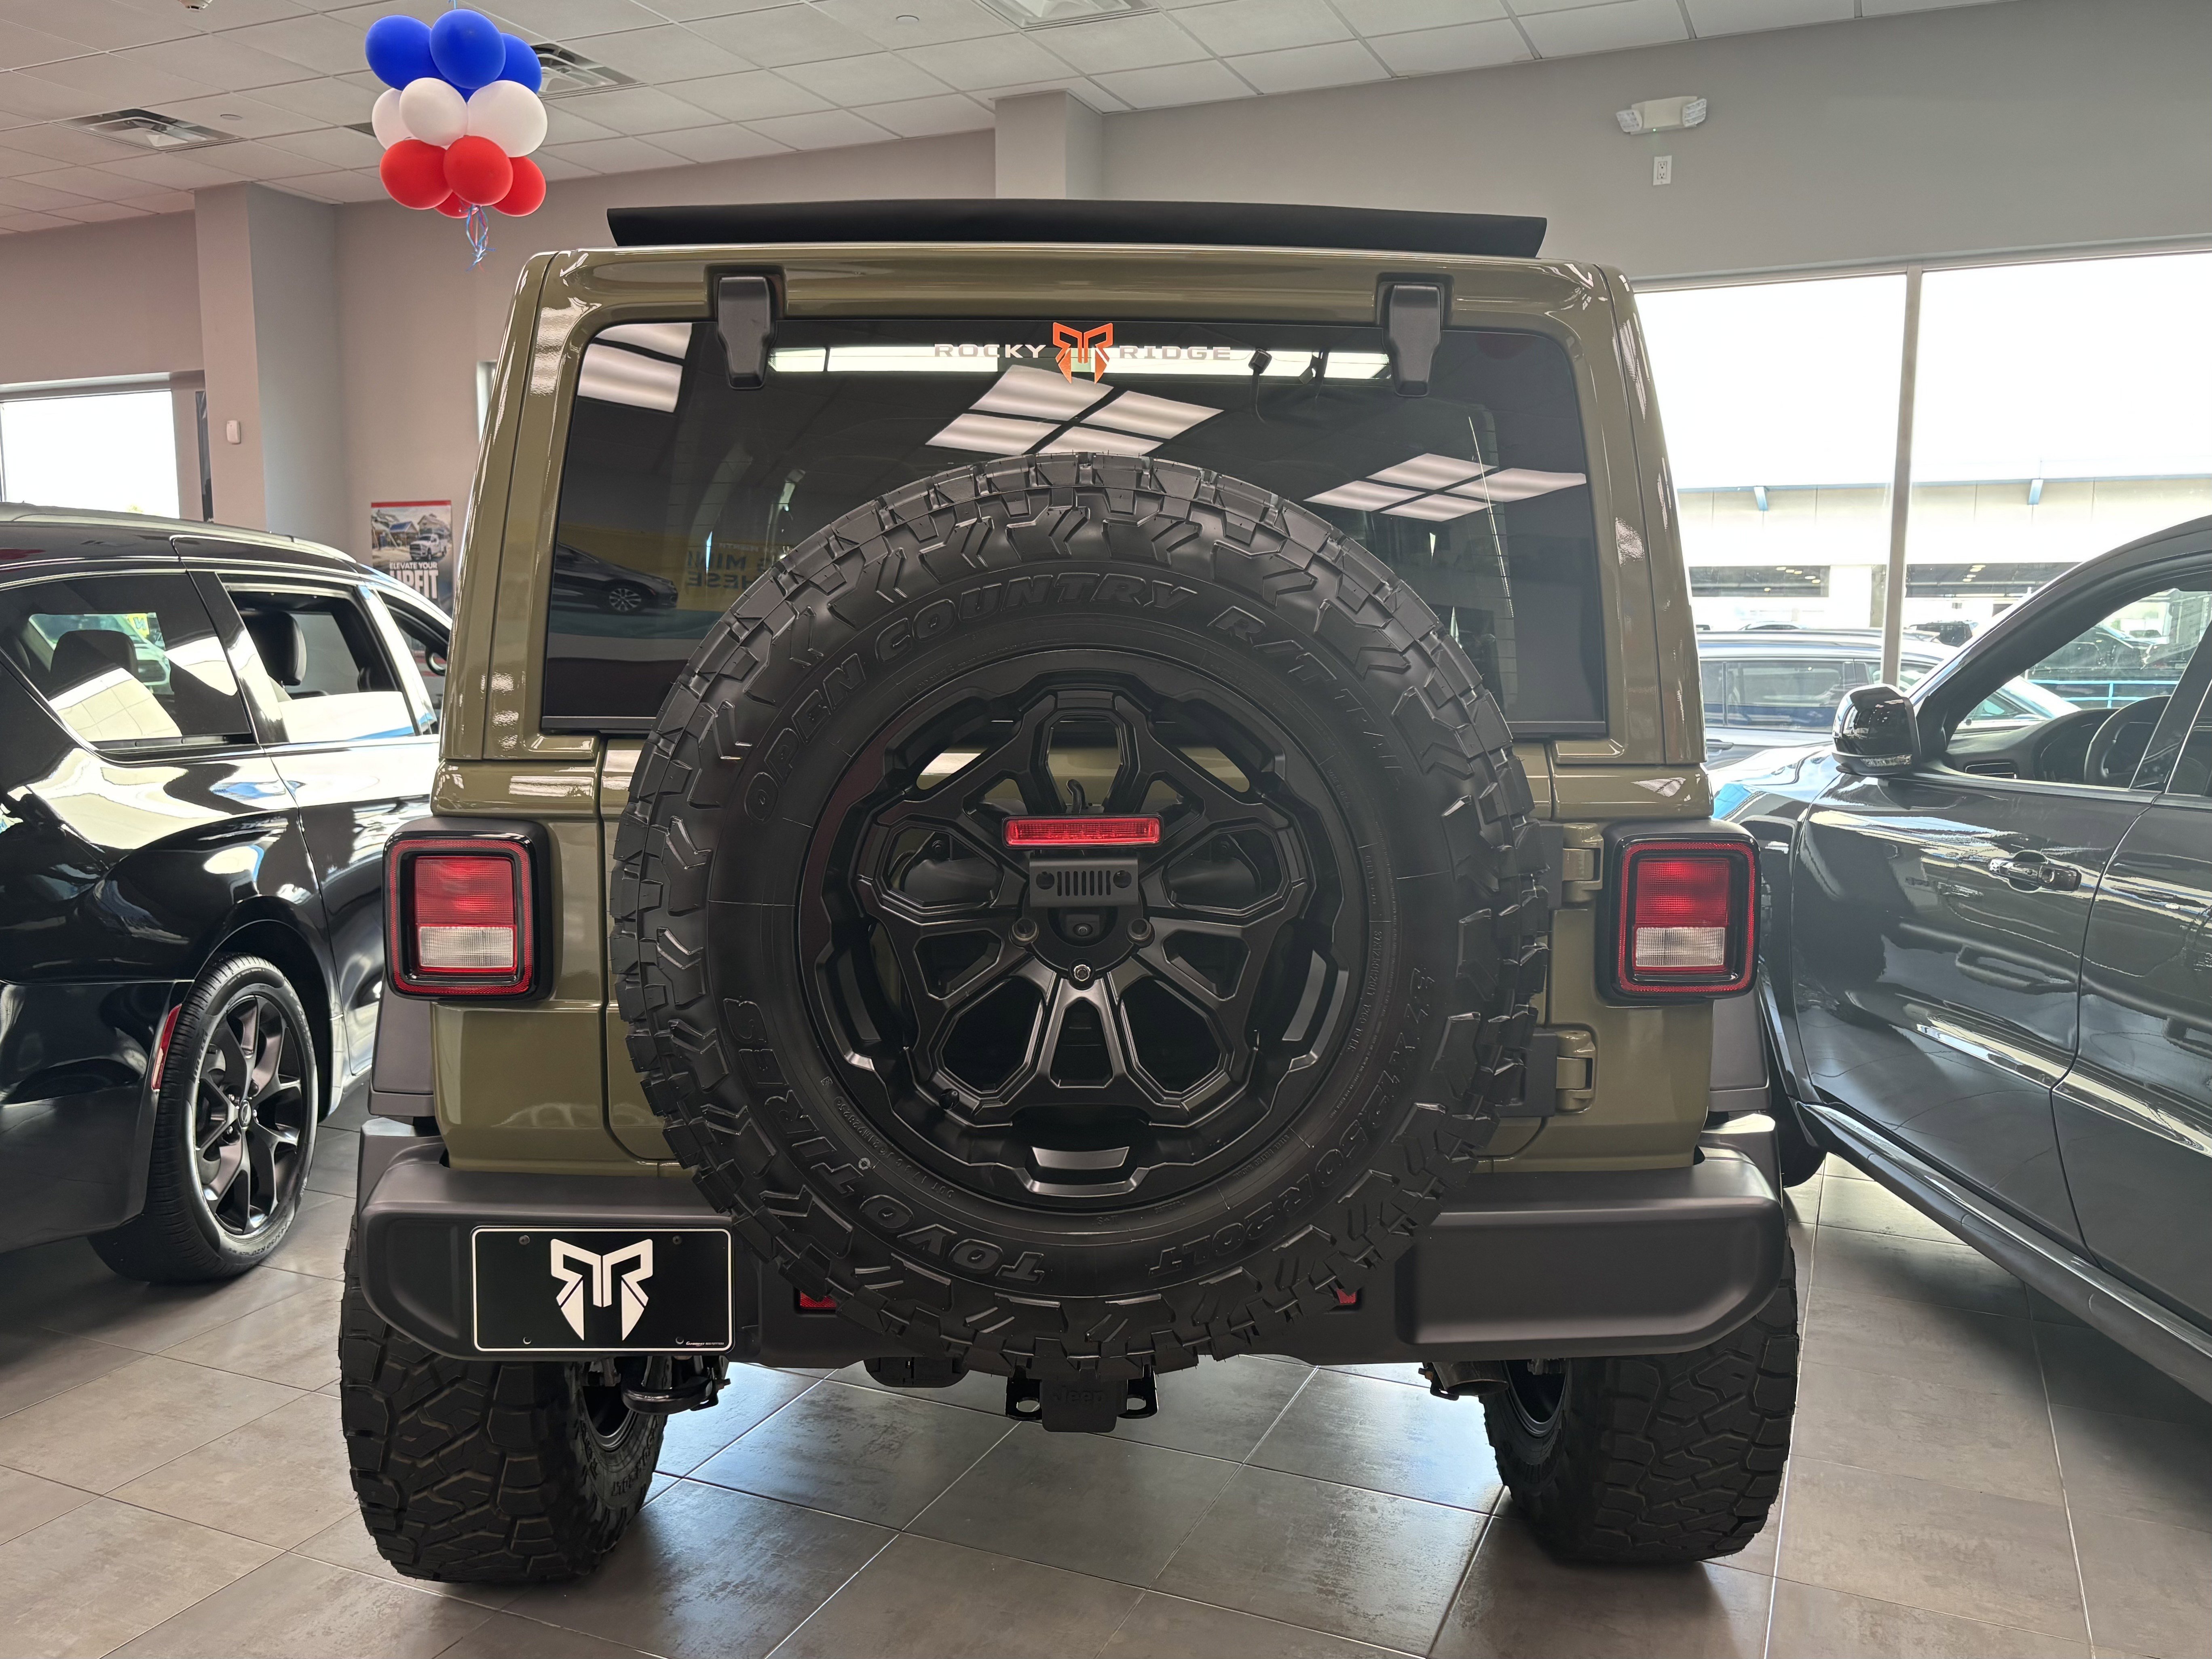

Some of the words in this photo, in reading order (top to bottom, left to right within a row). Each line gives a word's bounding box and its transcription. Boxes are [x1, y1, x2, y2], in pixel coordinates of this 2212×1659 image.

[934, 344, 1046, 359] ROCKY
[1119, 345, 1232, 361] RIDGE
[389, 562, 417, 570] ELEVATE
[418, 561, 437, 569] YOUR
[744, 653, 866, 822] OPEN
[874, 572, 1198, 664] COUNTRY
[1206, 605, 1338, 688] R/T
[723, 999, 864, 1197] TIRES
[858, 1194, 1044, 1284] TOYO
[1053, 1385, 1105, 1409] Jeep
